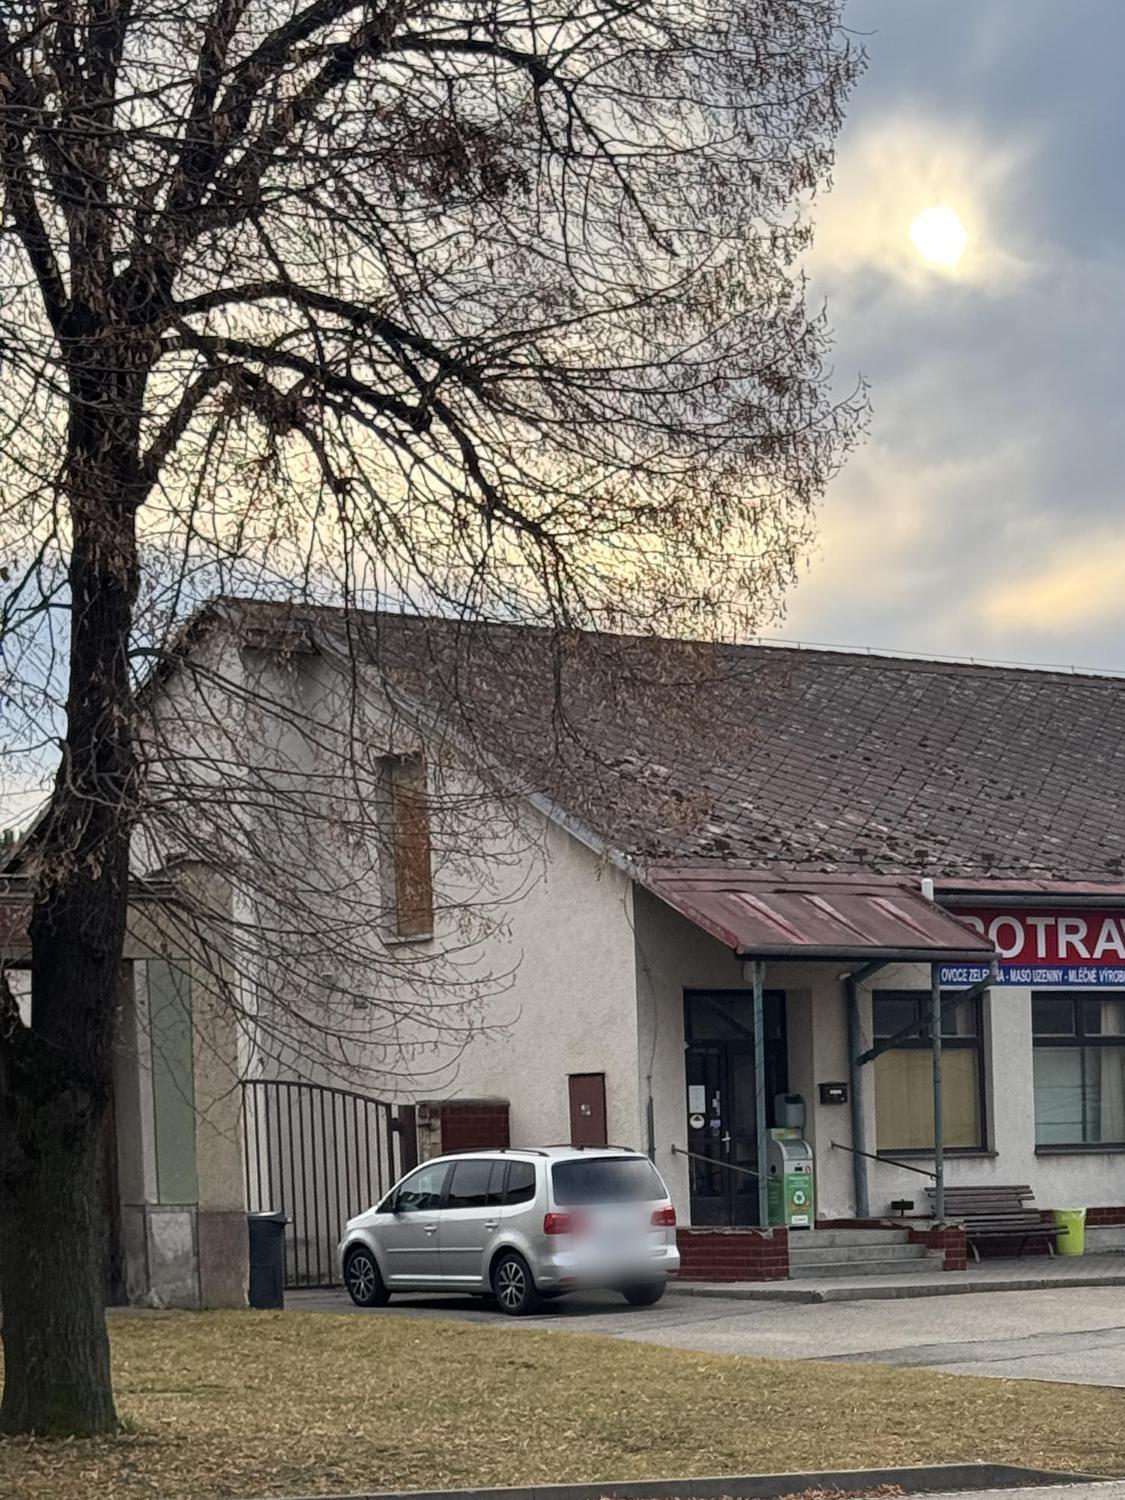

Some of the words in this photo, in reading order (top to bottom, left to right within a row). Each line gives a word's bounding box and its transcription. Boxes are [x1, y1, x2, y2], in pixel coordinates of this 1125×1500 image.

[941, 968, 968, 982] OVOCE
[1010, 969, 1031, 982] MASO
[1032, 969, 1063, 983] UZENINY
